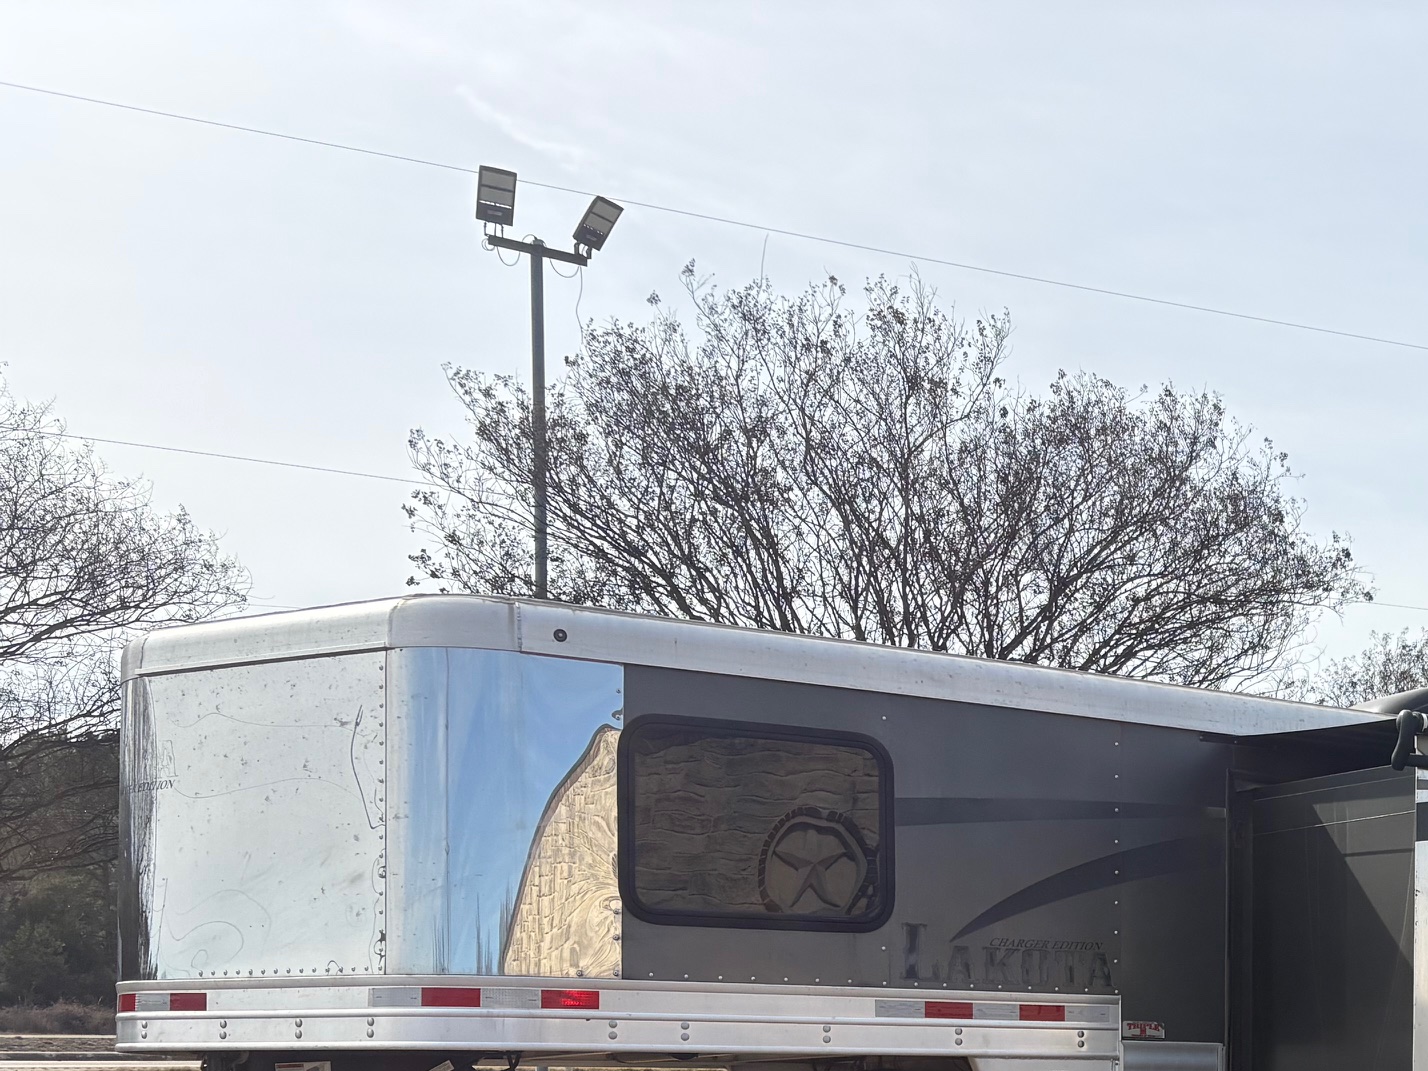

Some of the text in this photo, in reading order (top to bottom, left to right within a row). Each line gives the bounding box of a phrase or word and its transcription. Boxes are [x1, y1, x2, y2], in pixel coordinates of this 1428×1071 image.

[900, 922, 1117, 988] LAKOTA
[989, 937, 1104, 951] CHARGER EDITION
